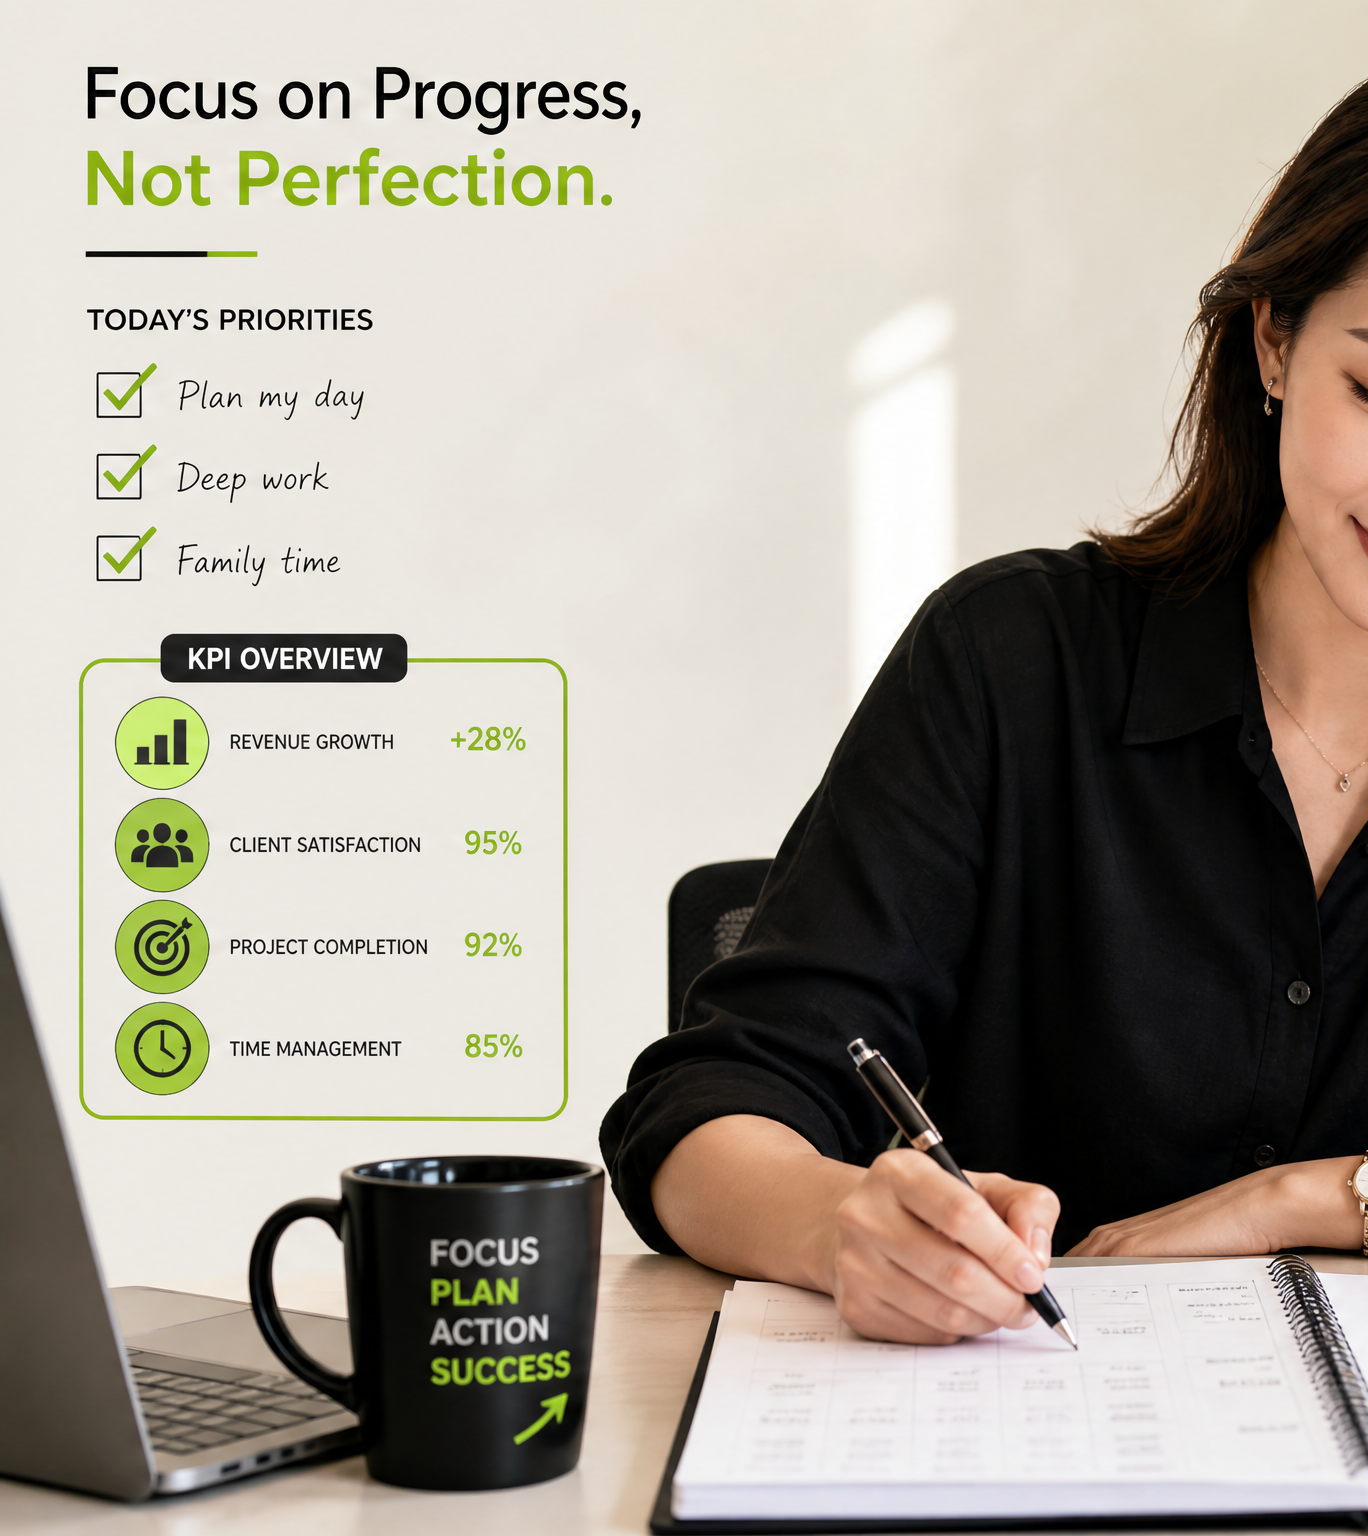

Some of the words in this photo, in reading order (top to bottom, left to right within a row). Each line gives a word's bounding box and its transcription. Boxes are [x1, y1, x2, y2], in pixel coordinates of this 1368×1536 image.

[430, 1235, 540, 1268] FOCUS
[430, 1276, 520, 1307] PLAN
[429, 1313, 550, 1346] ACTION
[431, 1349, 572, 1386] SUCCESS
